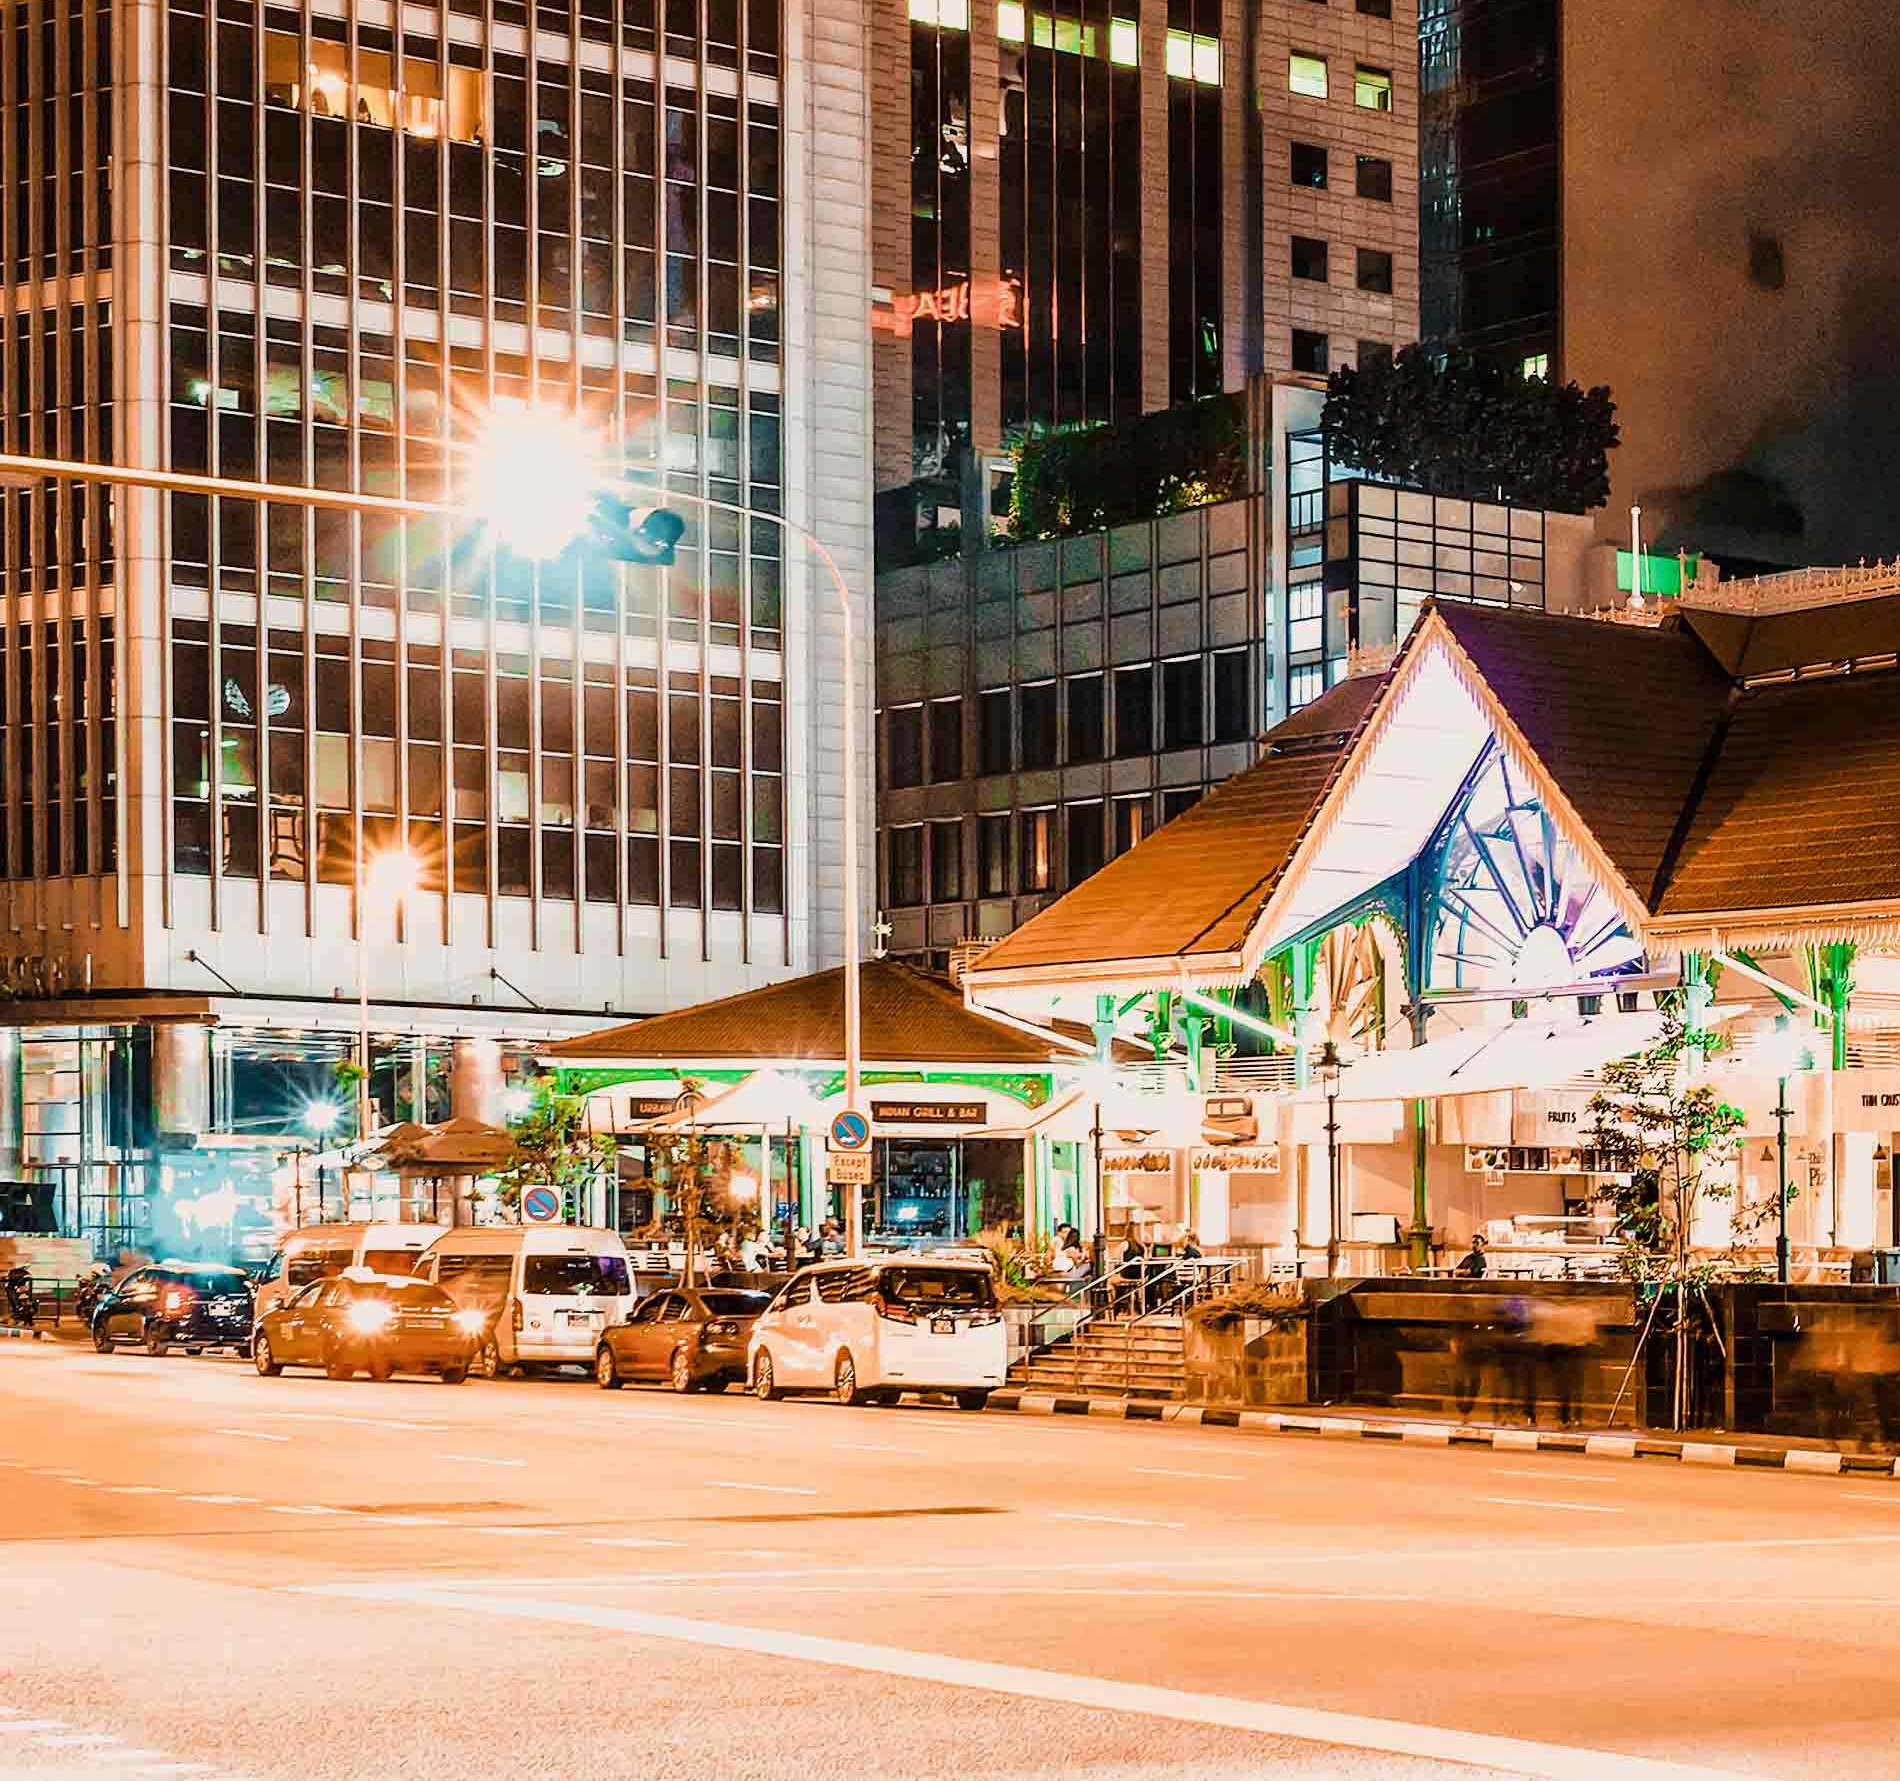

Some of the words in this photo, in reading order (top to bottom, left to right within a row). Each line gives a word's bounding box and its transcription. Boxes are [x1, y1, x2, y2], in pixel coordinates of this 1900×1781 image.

[913, 1106, 945, 1118] GRILL
[959, 1107, 979, 1118] BAR
[1548, 1110, 1577, 1123] FRUITS
